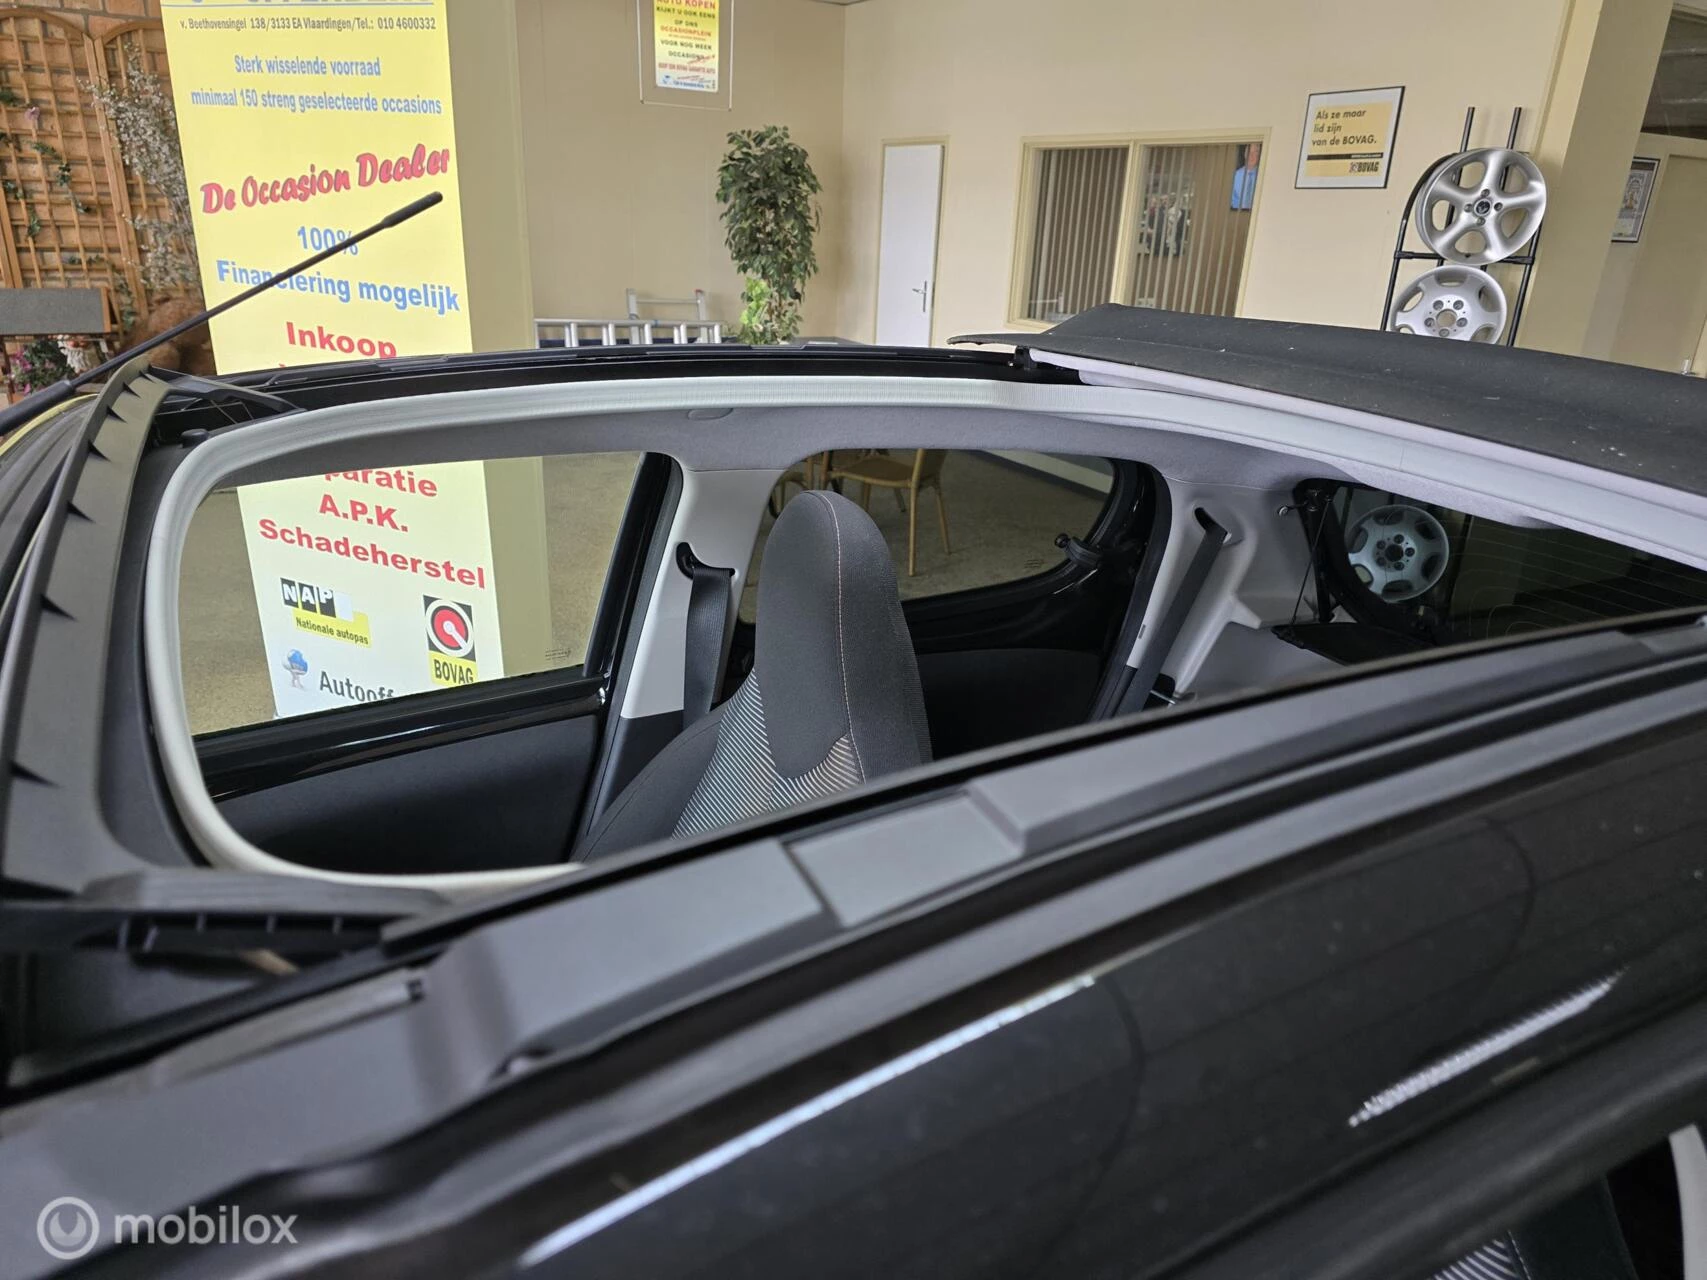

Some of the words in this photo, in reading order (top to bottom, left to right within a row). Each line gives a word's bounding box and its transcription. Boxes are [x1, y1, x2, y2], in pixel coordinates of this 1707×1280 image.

[685, 0, 715, 9] KOPEN
[188, 17, 247, 31] Beethovensingel
[377, 17, 394, 29] 010
[395, 17, 437, 30] 4600332
[234, 54, 263, 74] Sterk
[266, 56, 327, 75] wisselende
[330, 57, 381, 77] voorraad
[191, 88, 238, 107] minimaal
[240, 89, 258, 108] 150
[262, 92, 296, 113] streng
[299, 92, 378, 113] geselecteerde
[382, 95, 442, 115] occasions
[1316, 110, 1329, 120] Als
[1330, 111, 1341, 119] ze
[1343, 110, 1366, 118] maar
[1311, 138, 1327, 147] van
[1329, 136, 1340, 146] de
[1342, 134, 1377, 146] BOVAG.
[1314, 123, 1325, 133] lid
[1327, 123, 1342, 135] zijn
[200, 182, 236, 214] De
[242, 163, 351, 208] Occasion
[356, 143, 450, 187] Dealer
[1358, 161, 1379, 172] BOVAG
[297, 225, 358, 256] 100%
[359, 281, 461, 316] mogelijk
[286, 321, 398, 360] Inkoop
[319, 493, 408, 532] A.P.K.
[258, 518, 486, 589] Schadeherstel
[281, 581, 335, 606] NAP
[295, 616, 335, 636] Nationale
[336, 628, 369, 646] autopas
[433, 658, 474, 685] BOVAG
